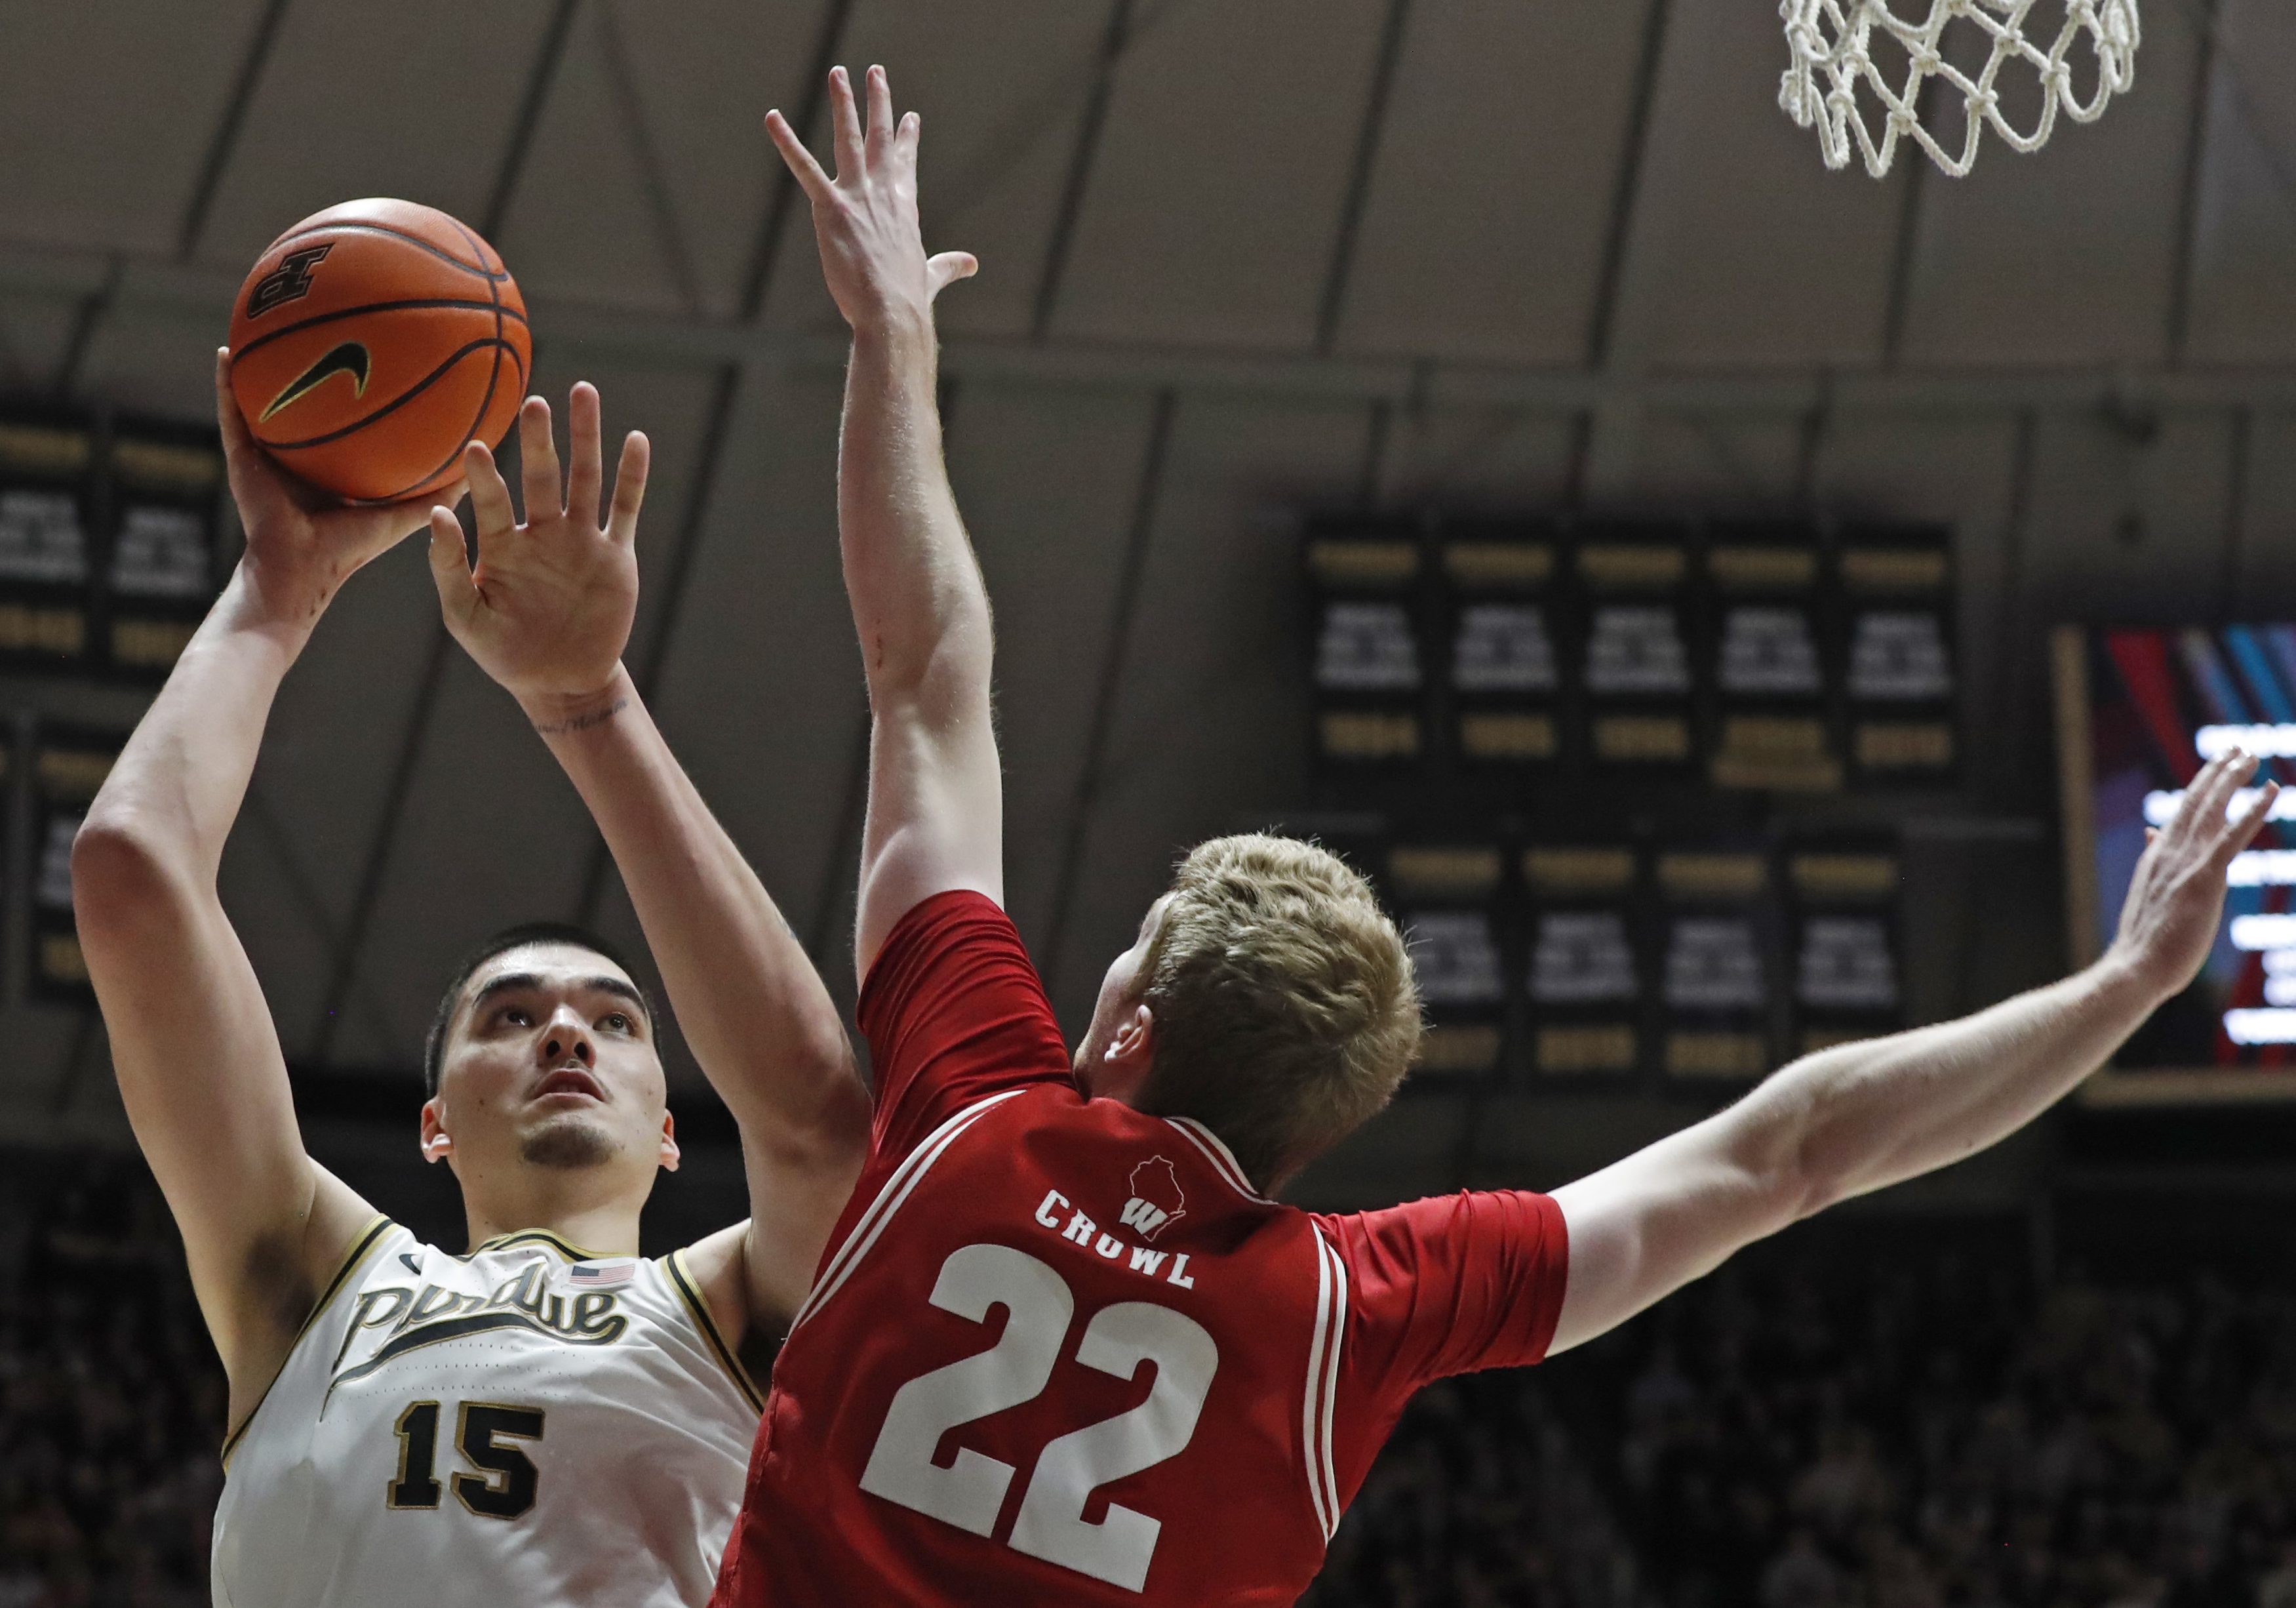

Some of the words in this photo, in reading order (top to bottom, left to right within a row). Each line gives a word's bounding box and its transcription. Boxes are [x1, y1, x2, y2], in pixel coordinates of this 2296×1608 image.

[1035, 1189, 1195, 1290] CROWL
[1118, 1197, 1168, 1235] W
[328, 1262, 629, 1390] Purdue
[386, 1400, 545, 1521] 15
[858, 1243, 1219, 1594] 22
